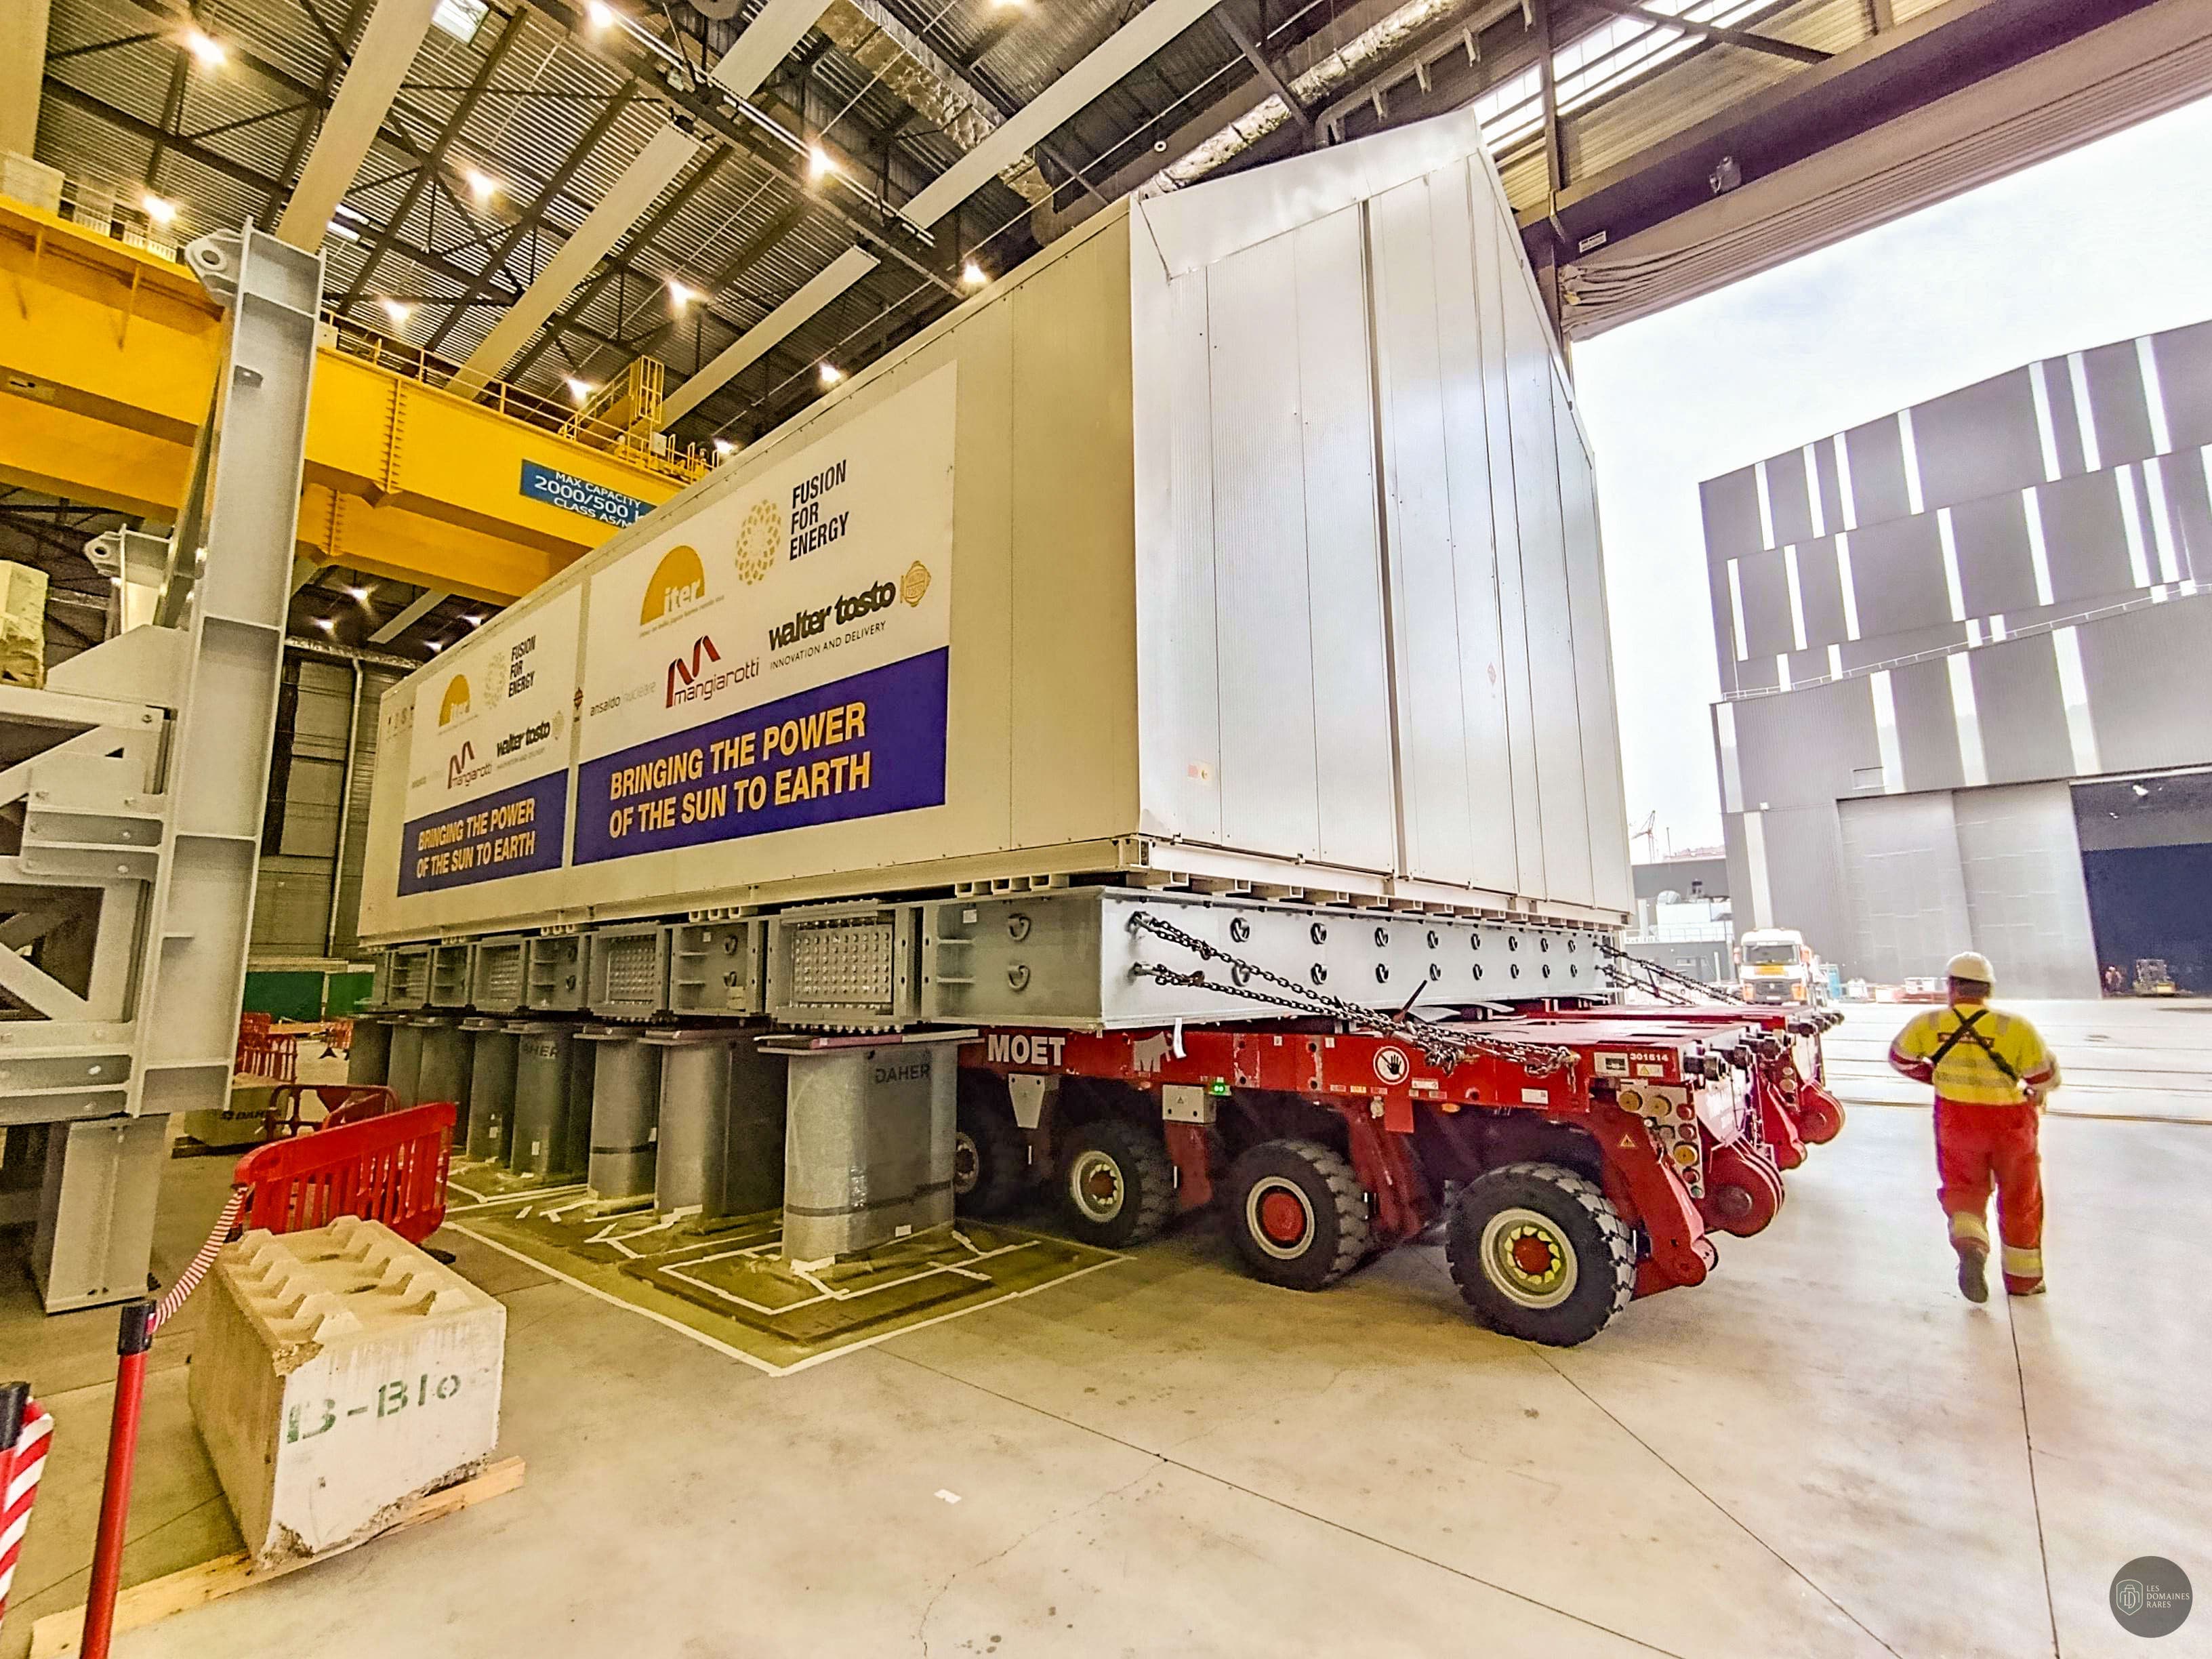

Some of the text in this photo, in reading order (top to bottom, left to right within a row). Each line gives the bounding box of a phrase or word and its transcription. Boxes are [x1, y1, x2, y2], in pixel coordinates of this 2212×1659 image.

[535, 475, 628, 518] 2000/500
[556, 472, 642, 508] MAX CAPACITY
[792, 459, 846, 509] FUSION
[554, 497, 596, 518] CLASS
[791, 501, 819, 535] FOR
[790, 511, 849, 560] ENERGY
[664, 578, 701, 615] iter
[769, 606, 832, 651] walter
[834, 580, 896, 625] tosto
[511, 634, 536, 661] FUSION
[770, 620, 886, 670] INNOVATION AND DELIVERY
[508, 670, 535, 698] ENERGY
[510, 660, 523, 680] FOR
[674, 657, 760, 706] mangiarotti
[590, 695, 621, 716] ansaldo
[611, 701, 865, 800] BRINGING THE POWER
[609, 751, 871, 838] OF THE SUN TO EARTH
[417, 797, 535, 851] BRINGING THE POWER
[416, 830, 535, 878] OF THE SUN TO EARTH
[988, 1034, 1065, 1066] MOET
[876, 1063, 931, 1084] DAHER
